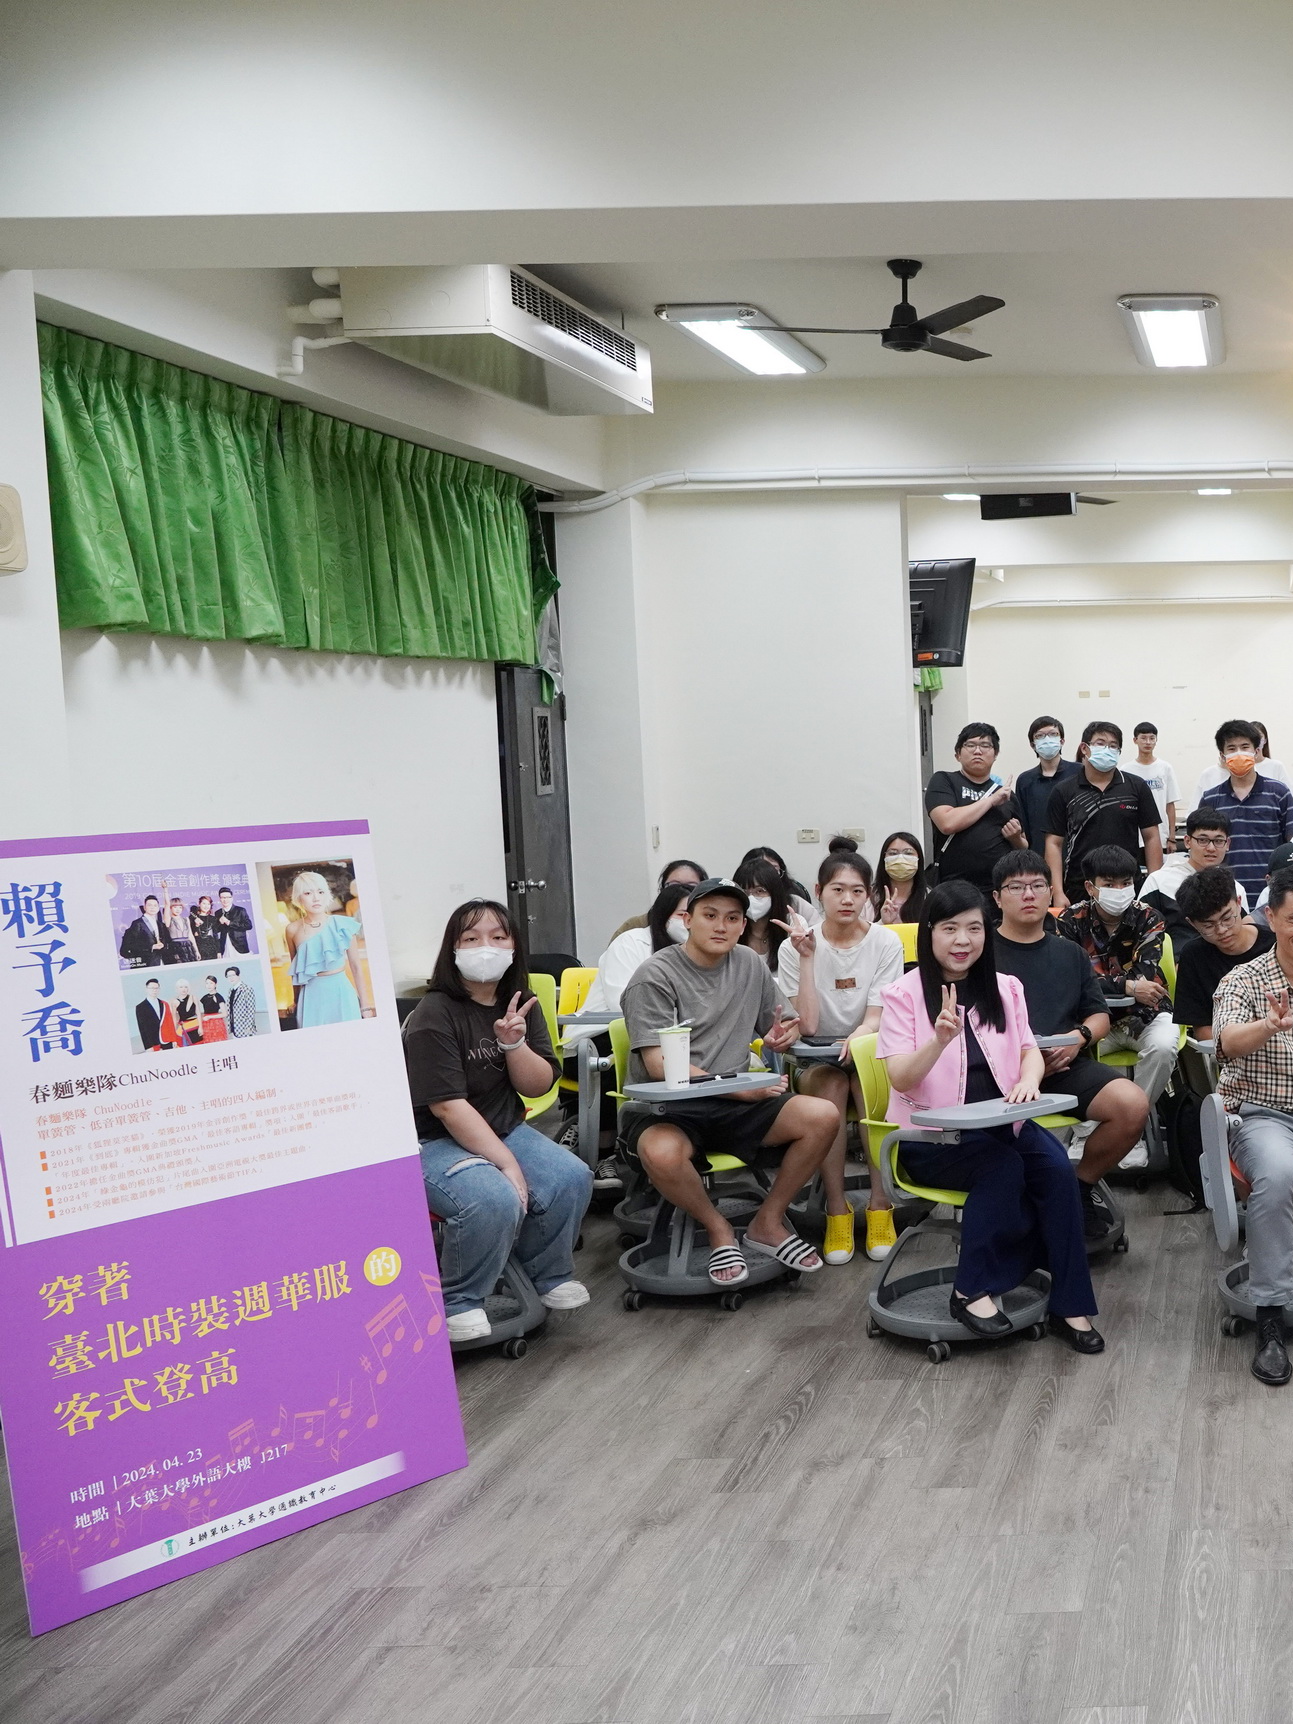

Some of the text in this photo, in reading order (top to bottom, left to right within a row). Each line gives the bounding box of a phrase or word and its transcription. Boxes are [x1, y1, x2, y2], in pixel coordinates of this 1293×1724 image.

[0, 880, 87, 1063] 賴予喬
[208, 1055, 239, 1074] 主唱
[36, 1108, 88, 1127] 春麵樂隊
[94, 1098, 153, 1116] ChuNoodle
[38, 1261, 131, 1321] 穿著
[47, 1252, 398, 1380] 臺北時裝週華服 的
[54, 1348, 238, 1437] 客式登高
[70, 1480, 105, 1504] 時間
[74, 1506, 110, 1529] 地點
[260, 1444, 288, 1464] J217
